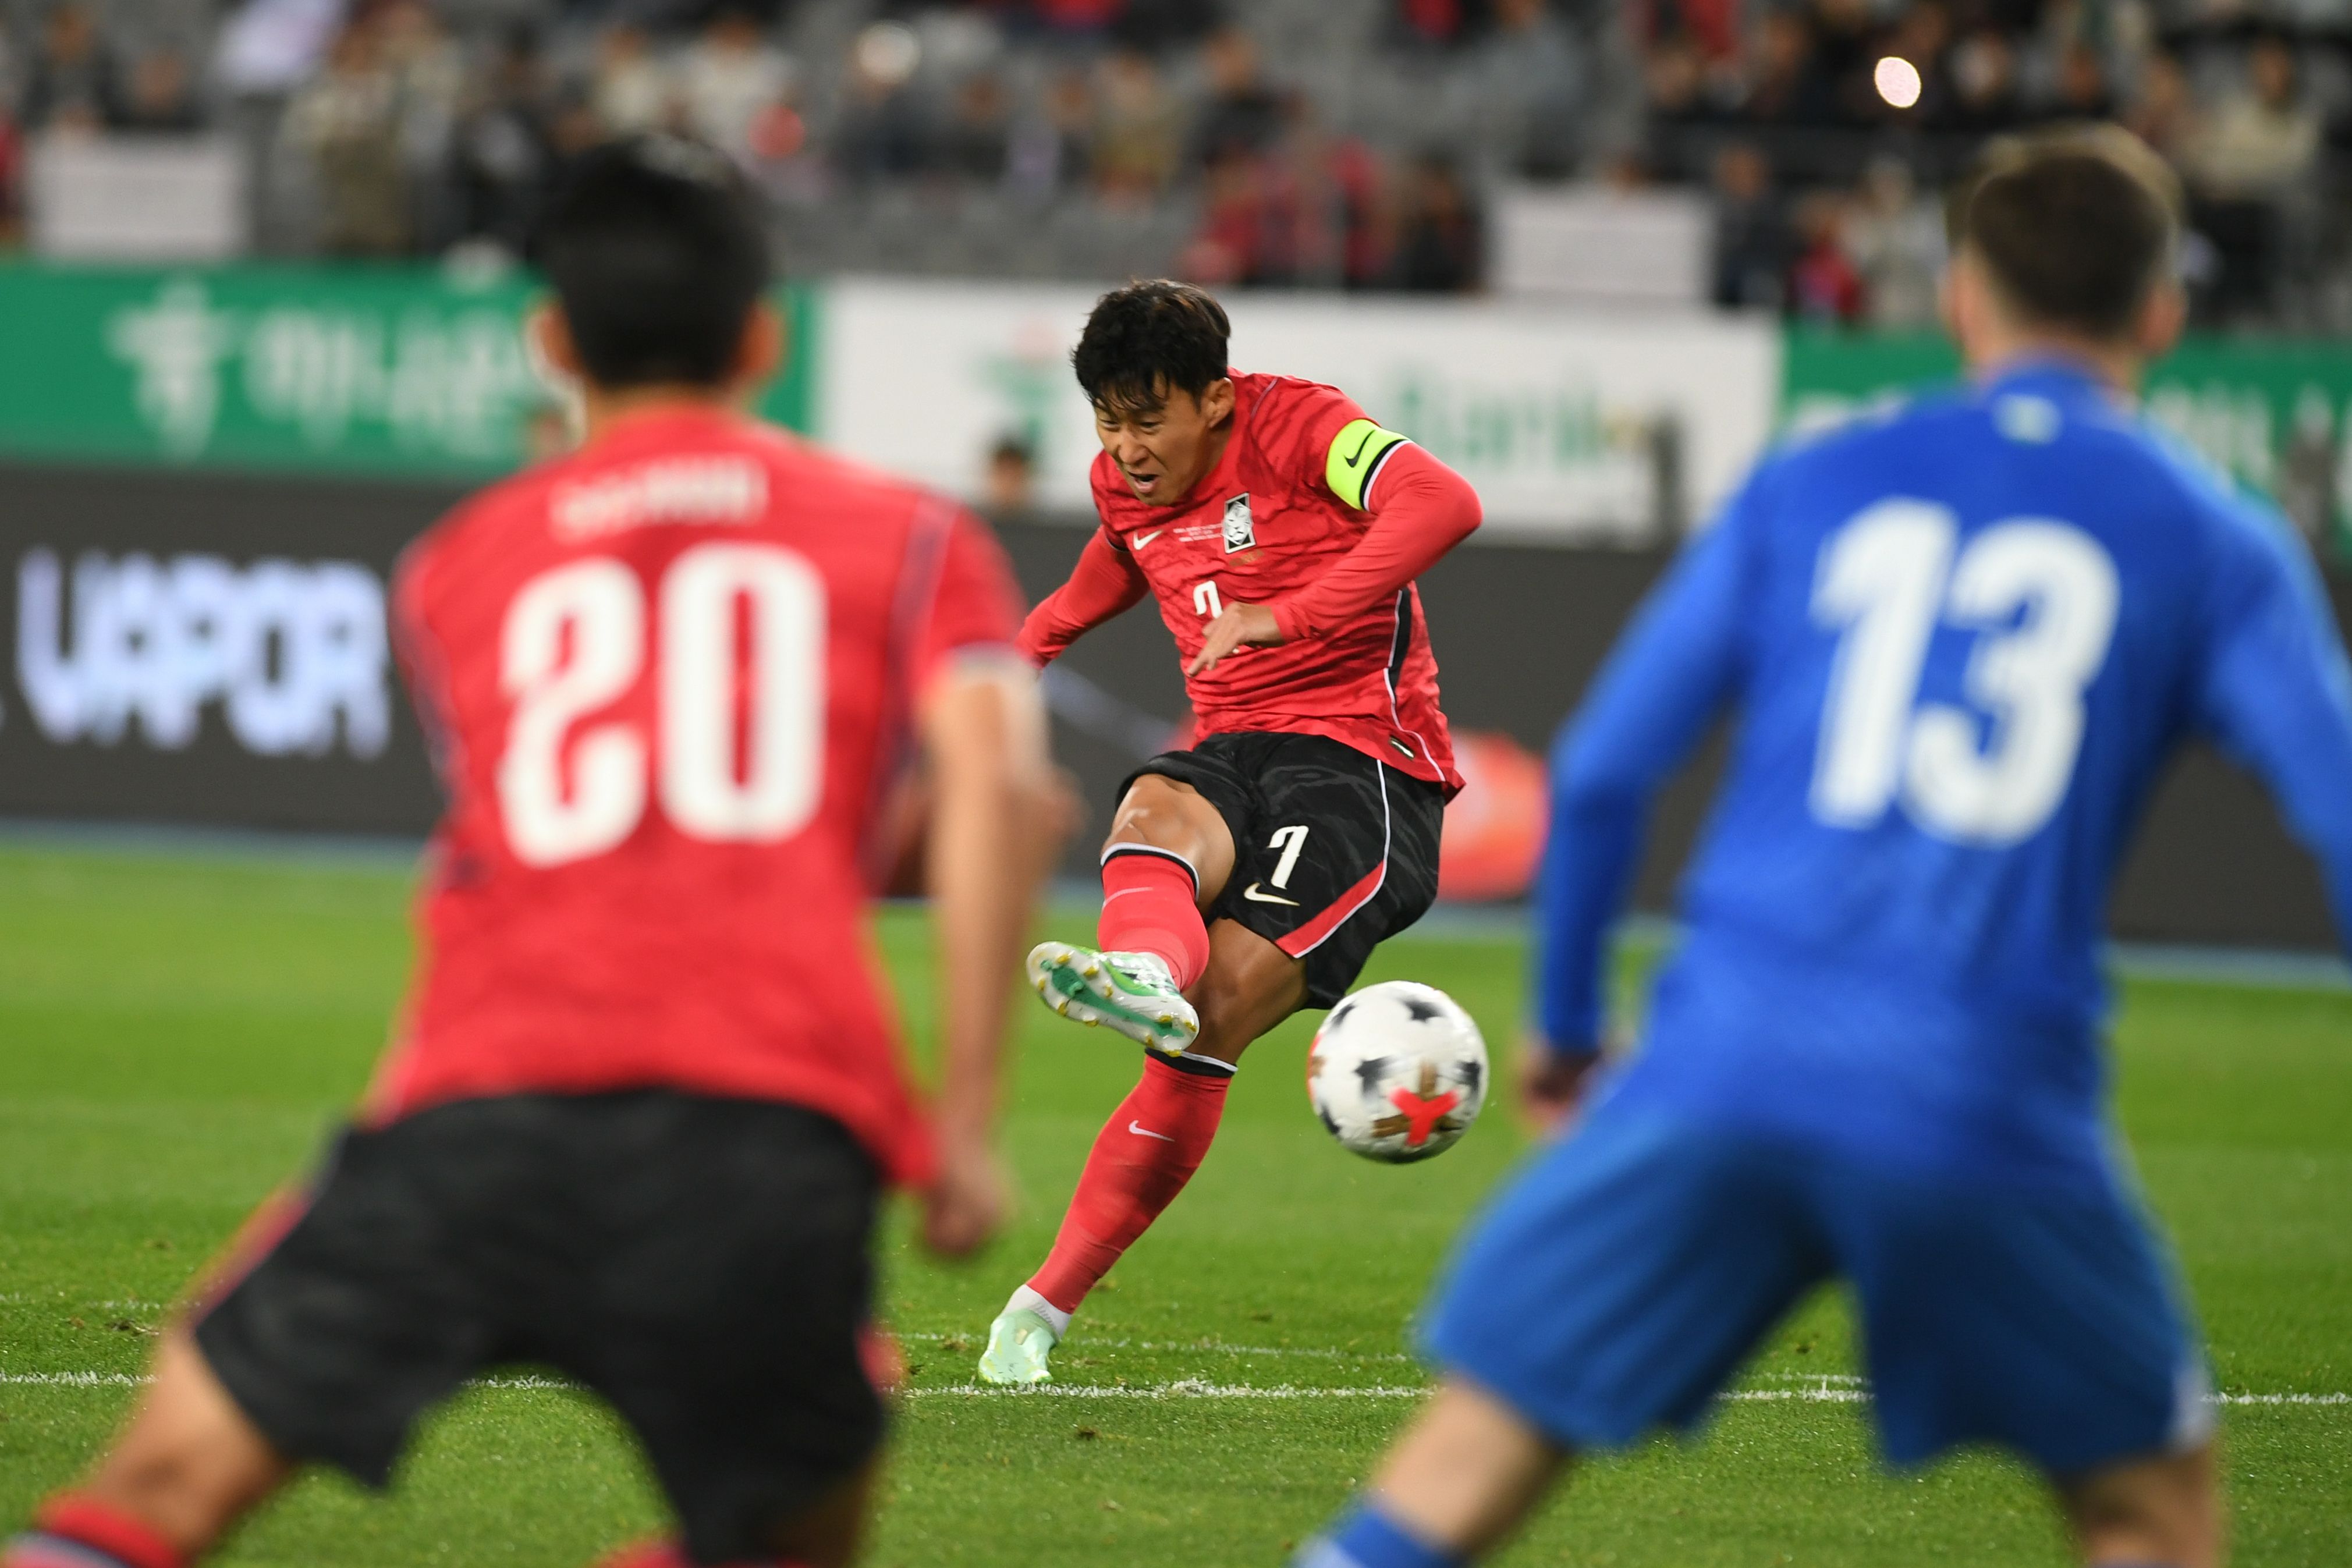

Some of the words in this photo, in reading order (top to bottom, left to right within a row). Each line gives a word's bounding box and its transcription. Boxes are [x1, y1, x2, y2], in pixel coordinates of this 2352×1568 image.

[499, 540, 824, 868] 20
[1809, 498, 2120, 849] 13
[1267, 825, 1310, 890] 7
